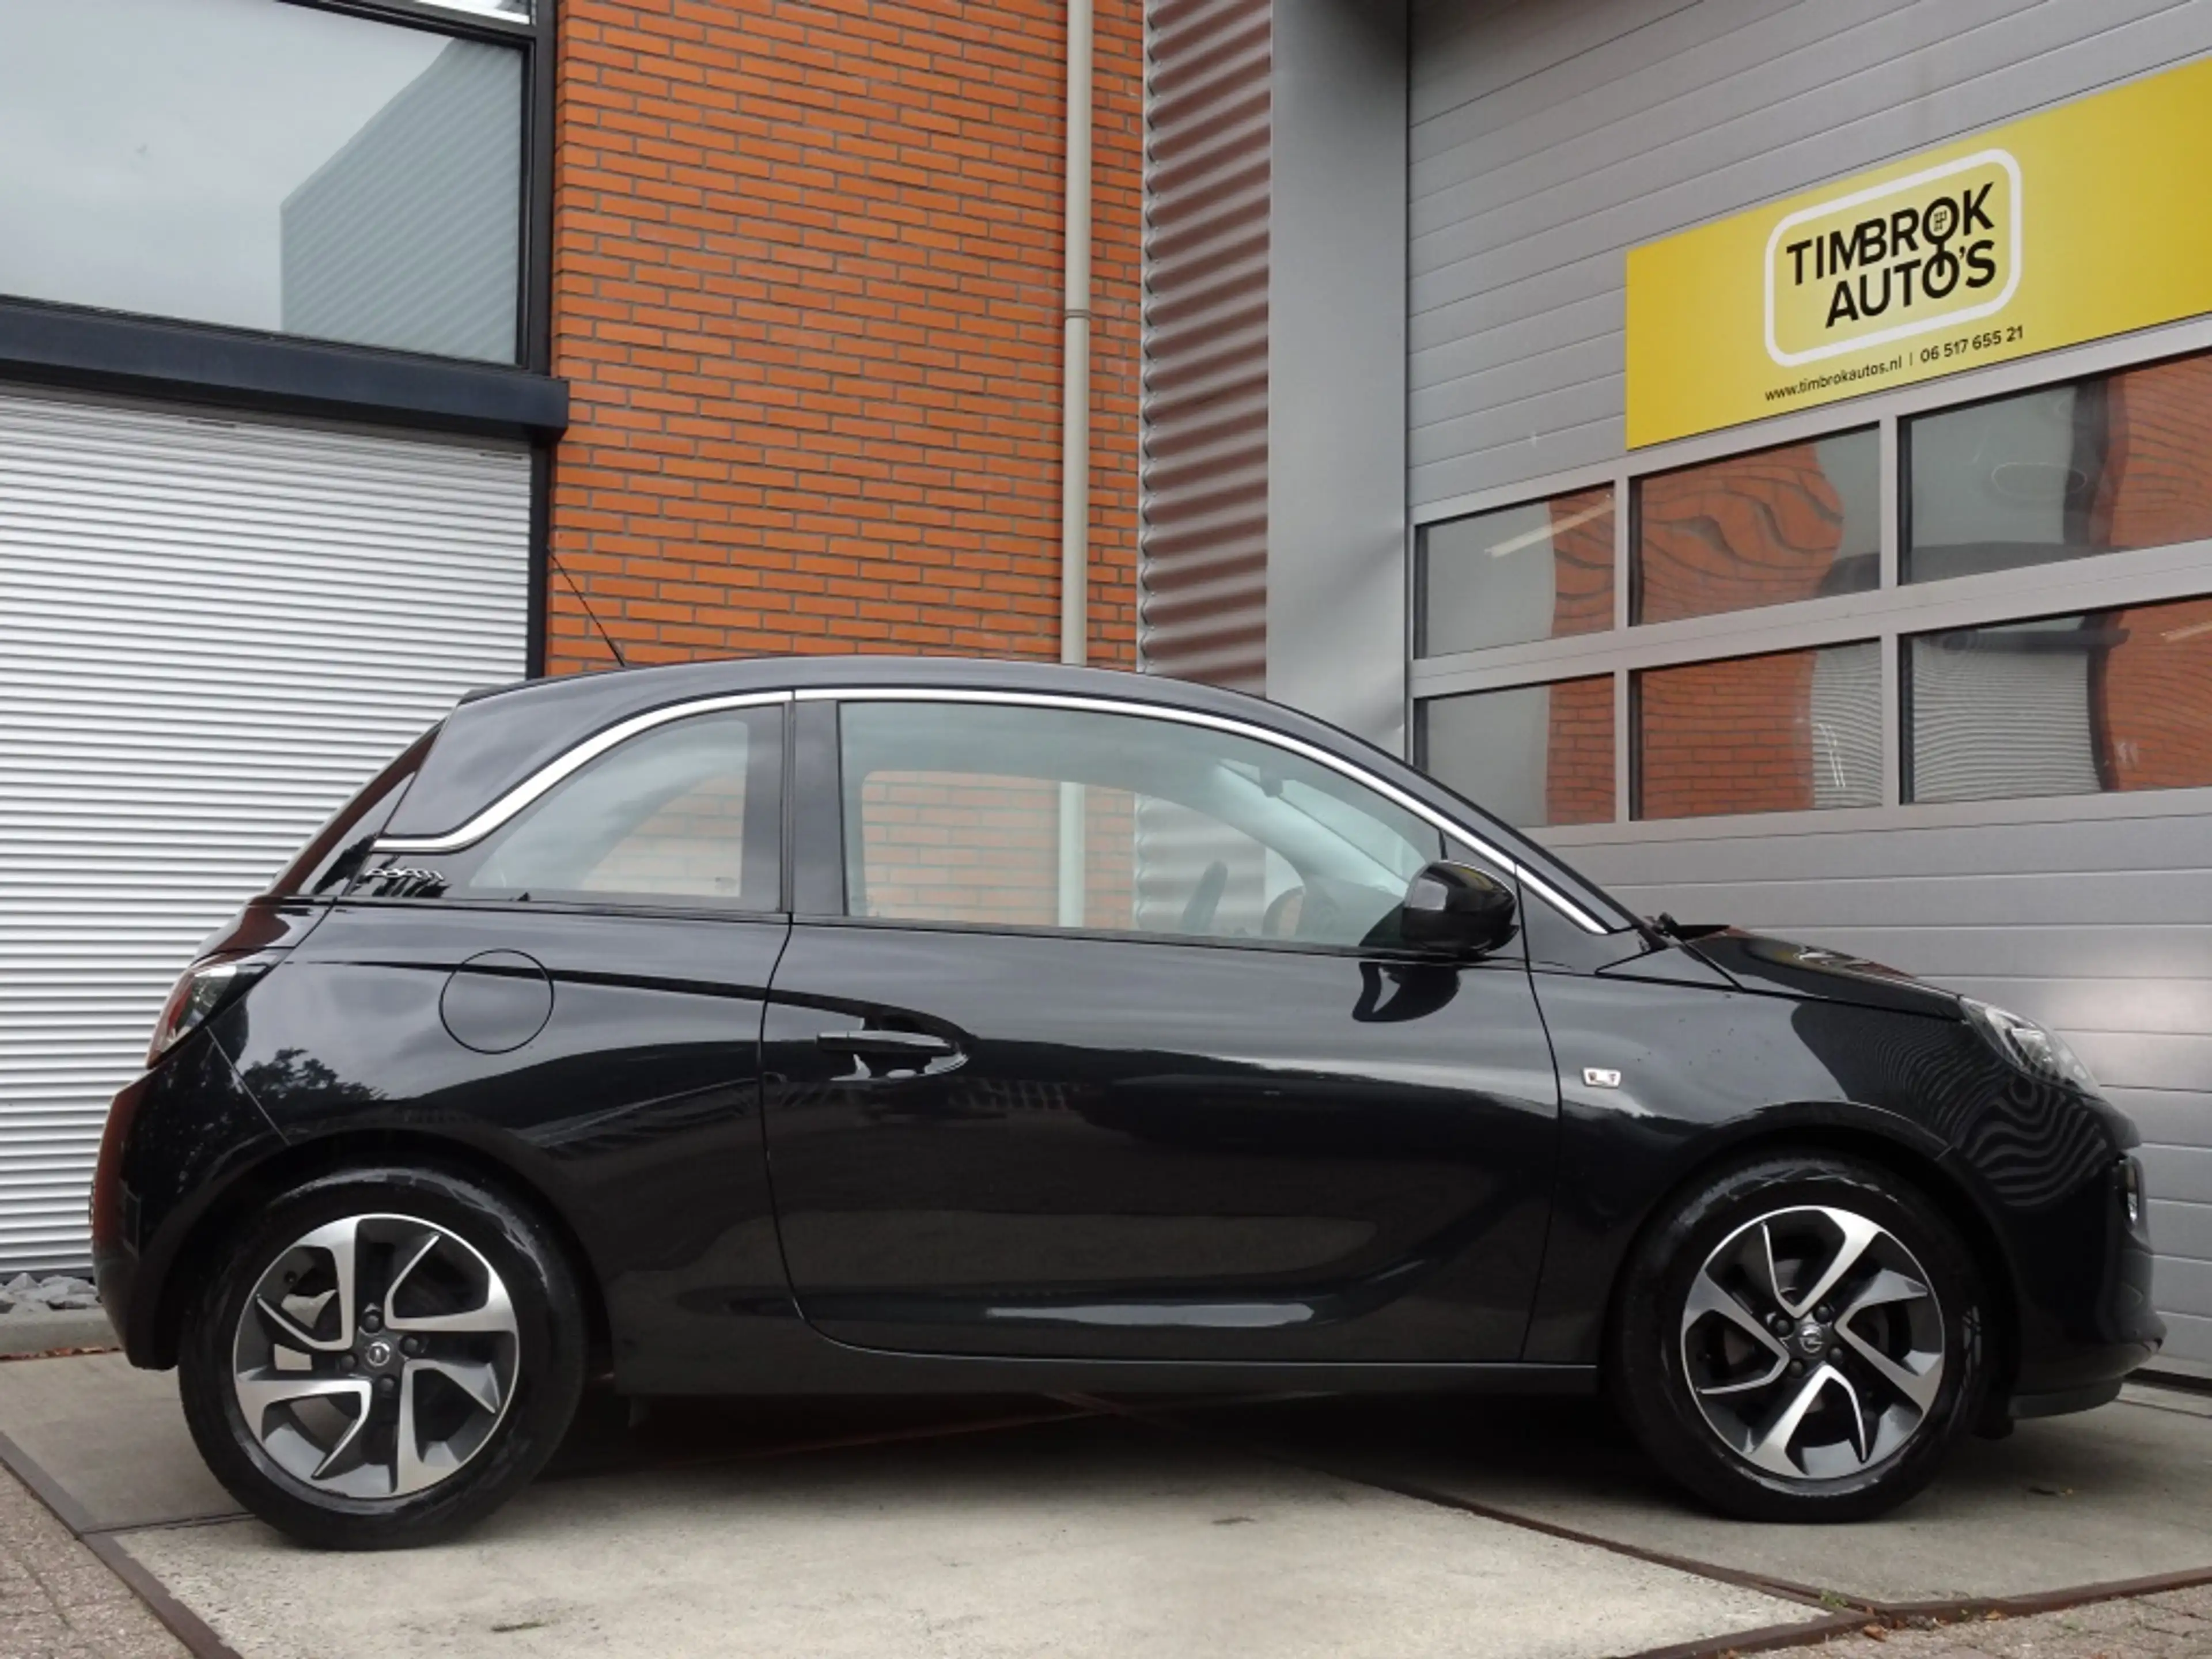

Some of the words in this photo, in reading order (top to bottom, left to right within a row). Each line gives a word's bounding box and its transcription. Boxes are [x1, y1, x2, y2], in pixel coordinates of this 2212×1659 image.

[1786, 181, 1995, 285] TIMBROK
[1825, 240, 1996, 328] AUTO'S
[1765, 356, 1902, 401] www.timbrokautos.nl
[1920, 345, 1940, 363] 06
[1944, 339, 1968, 358] 517
[1972, 331, 2002, 351] 655
[2006, 325, 2024, 342] 21
